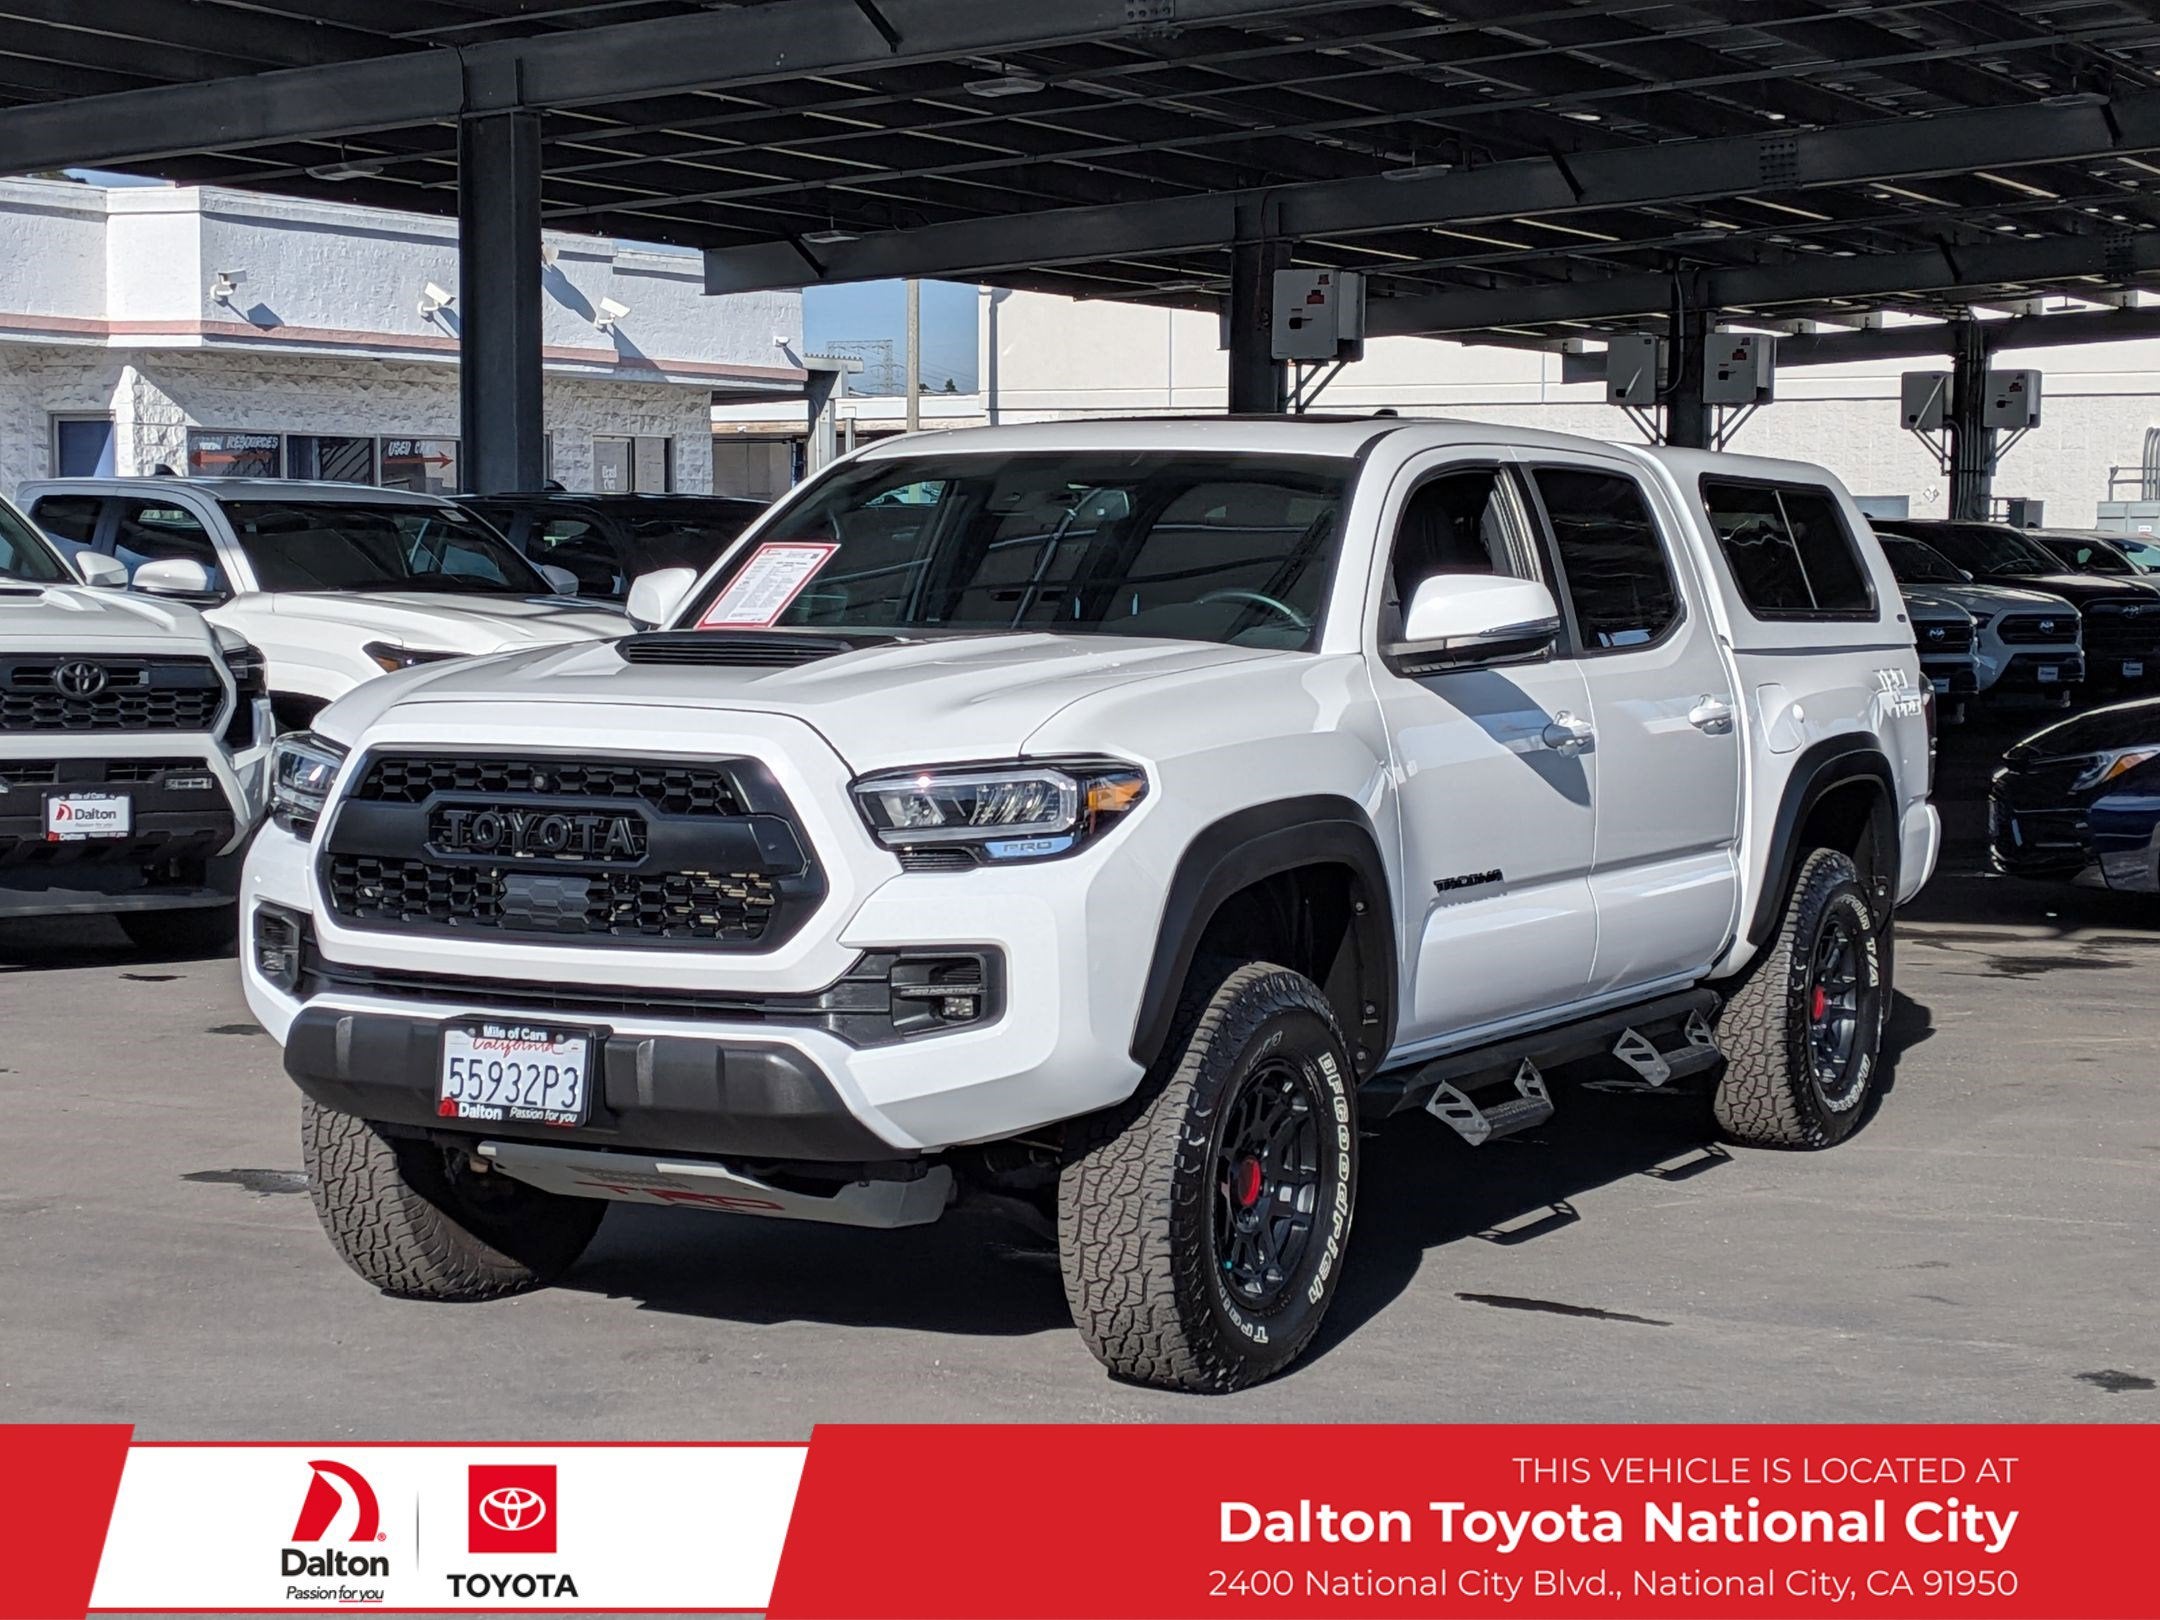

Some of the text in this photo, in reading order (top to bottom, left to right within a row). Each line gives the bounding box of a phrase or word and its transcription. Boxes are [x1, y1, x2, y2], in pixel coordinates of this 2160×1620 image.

[388, 440, 412, 457] USED
[74, 807, 117, 820] Dalton
[442, 808, 640, 856] TOYOTA
[1003, 841, 1052, 853] PRO
[482, 1024, 547, 1042] Mile of Cars
[472, 1037, 565, 1059] California
[449, 1057, 579, 1109] 55932P3
[458, 1102, 578, 1125] Dalton Passion for you
[1308, 1051, 1350, 1305] BFGoodrich
